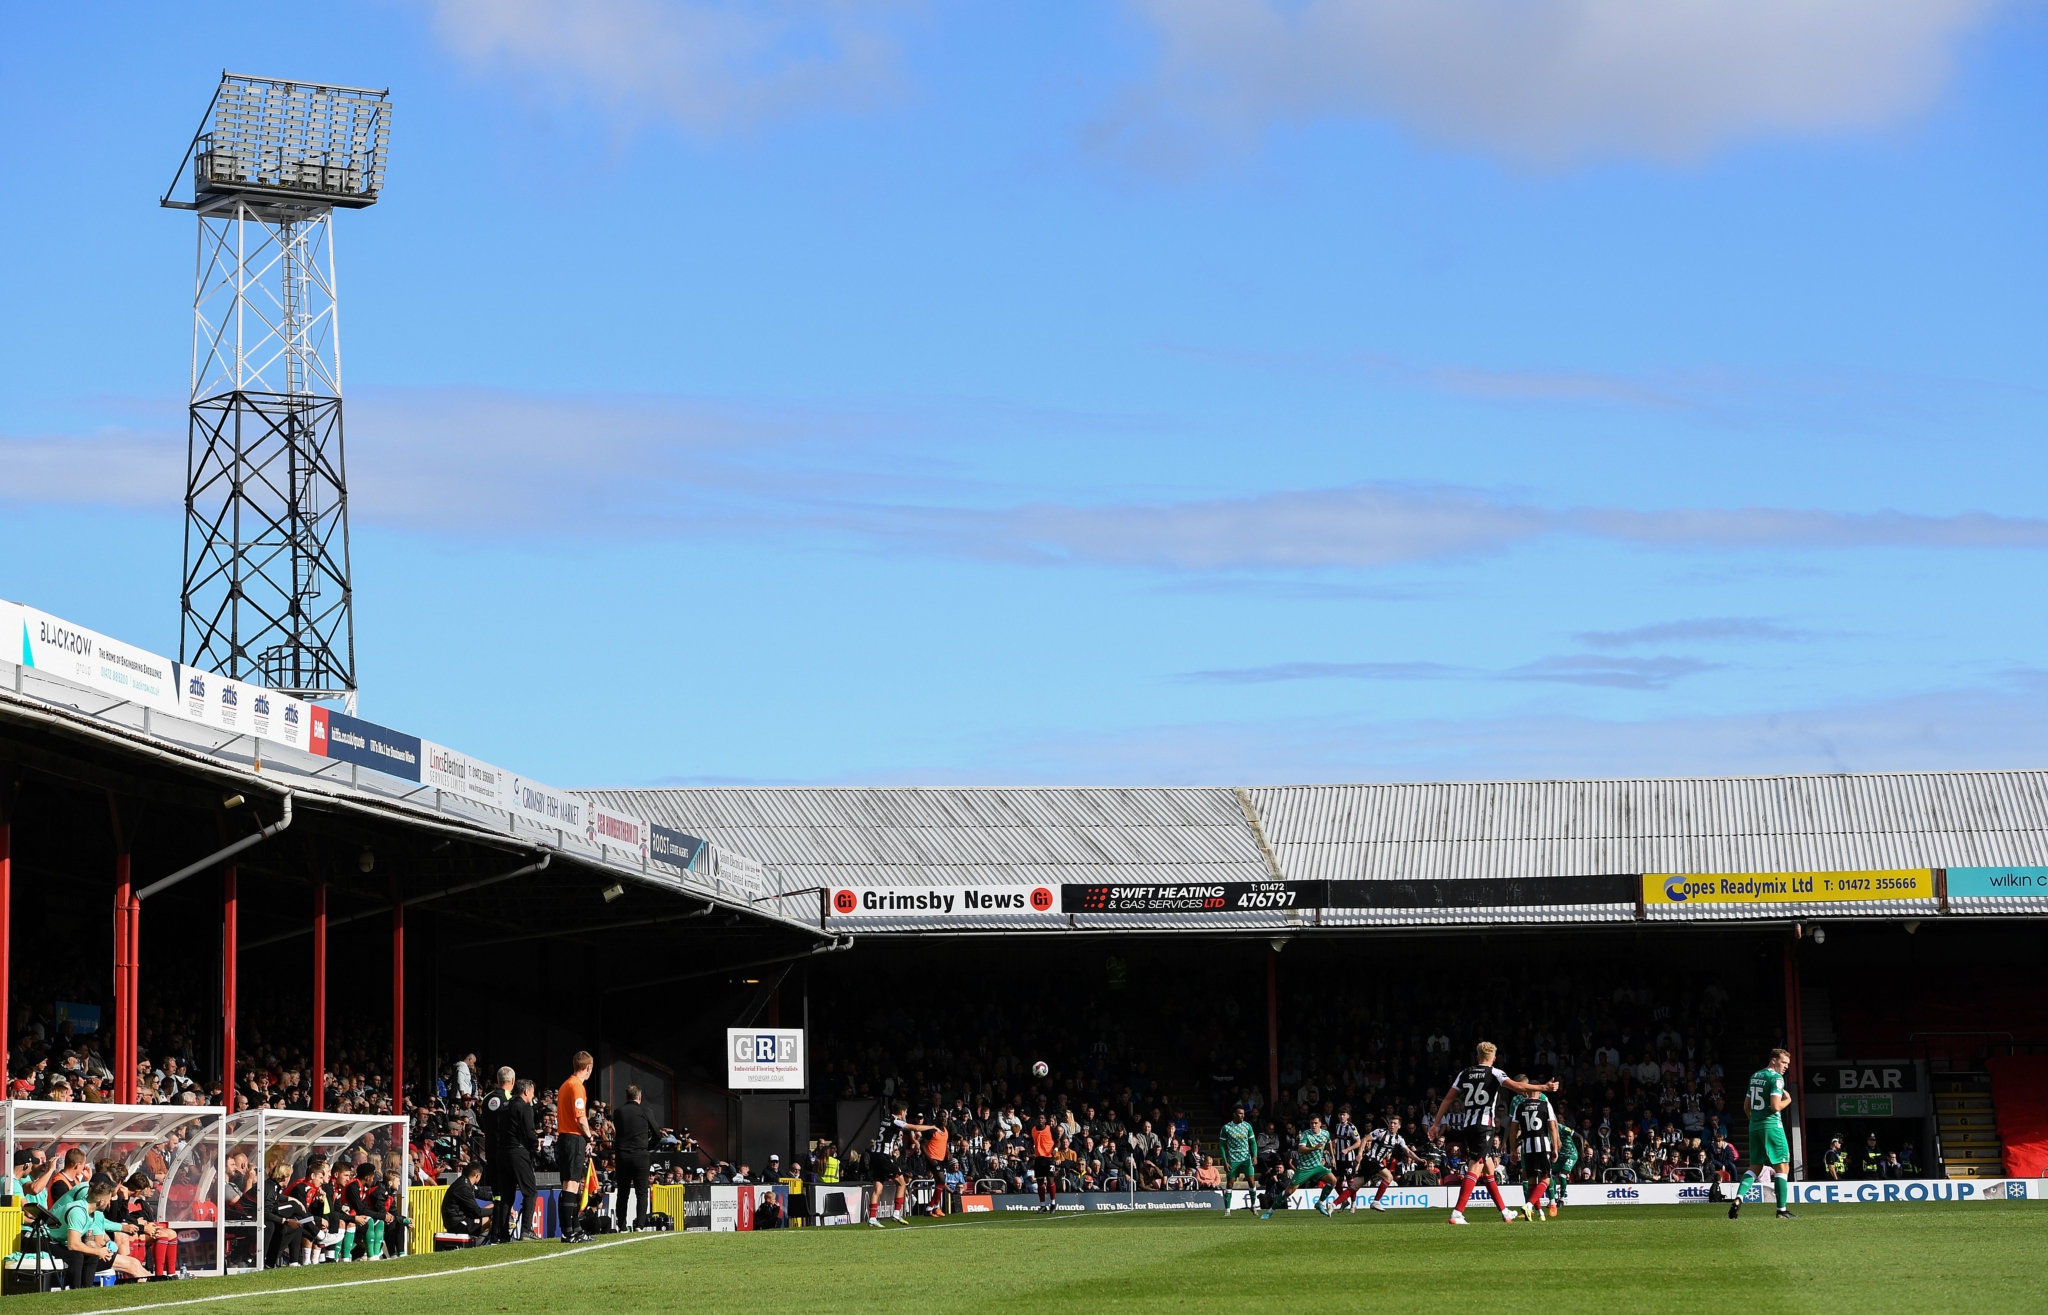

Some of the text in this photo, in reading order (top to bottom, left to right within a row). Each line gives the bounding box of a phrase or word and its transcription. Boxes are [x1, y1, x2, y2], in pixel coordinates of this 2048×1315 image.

[41, 621, 92, 657] BLACKROW
[75, 662, 92, 678] group
[189, 674, 205, 698] attis
[221, 684, 238, 706] attis
[254, 693, 270, 716] attis
[284, 703, 299, 724] attis
[522, 786, 546, 814] GRIMSBY
[546, 795, 559, 819] FISH
[559, 801, 580, 827] MARKET
[652, 832, 670, 855] ROOST
[1251, 883, 1285, 892] T: 01472
[1720, 877, 1787, 898] Readymix
[1792, 876, 1814, 893] Ltd
[1824, 879, 1834, 891] T:
[1838, 878, 1871, 890] 01472
[1875, 877, 1917, 890] 355666
[1989, 873, 2032, 887] wilkin
[1033, 891, 1049, 906] Gi
[1110, 886, 1225, 899] SWIFT HEATING
[1237, 891, 1297, 908] 476797
[837, 893, 853, 908] Gi
[862, 890, 1025, 914] Grimsby News
[1108, 898, 1226, 909] & GAS SERVICES LTD
[735, 1037, 795, 1061] GRF
[756, 1065, 775, 1073] Flooring
[775, 1065, 798, 1073] Specialists
[1468, 1072, 1486, 1080] SMITH
[1838, 1068, 1902, 1089] BAR
[1462, 1082, 1489, 1107] 26
[1749, 1086, 1766, 1111] 15
[1871, 1102, 1890, 1111] EXIT
[1957, 1101, 1965, 1109] H
[1521, 1110, 1543, 1131] 16
[1960, 1117, 1968, 1126] G
[878, 1127, 886, 1142] 3
[1962, 1134, 1970, 1142] F
[1965, 1150, 1973, 1159] E
[1967, 1167, 1975, 1176] D
[1606, 1187, 1640, 1199] attis
[1793, 1183, 1975, 1203] ICE-GROUP
[1096, 1203, 1116, 1211] UK's
[1185, 1201, 1212, 1209] Waste
